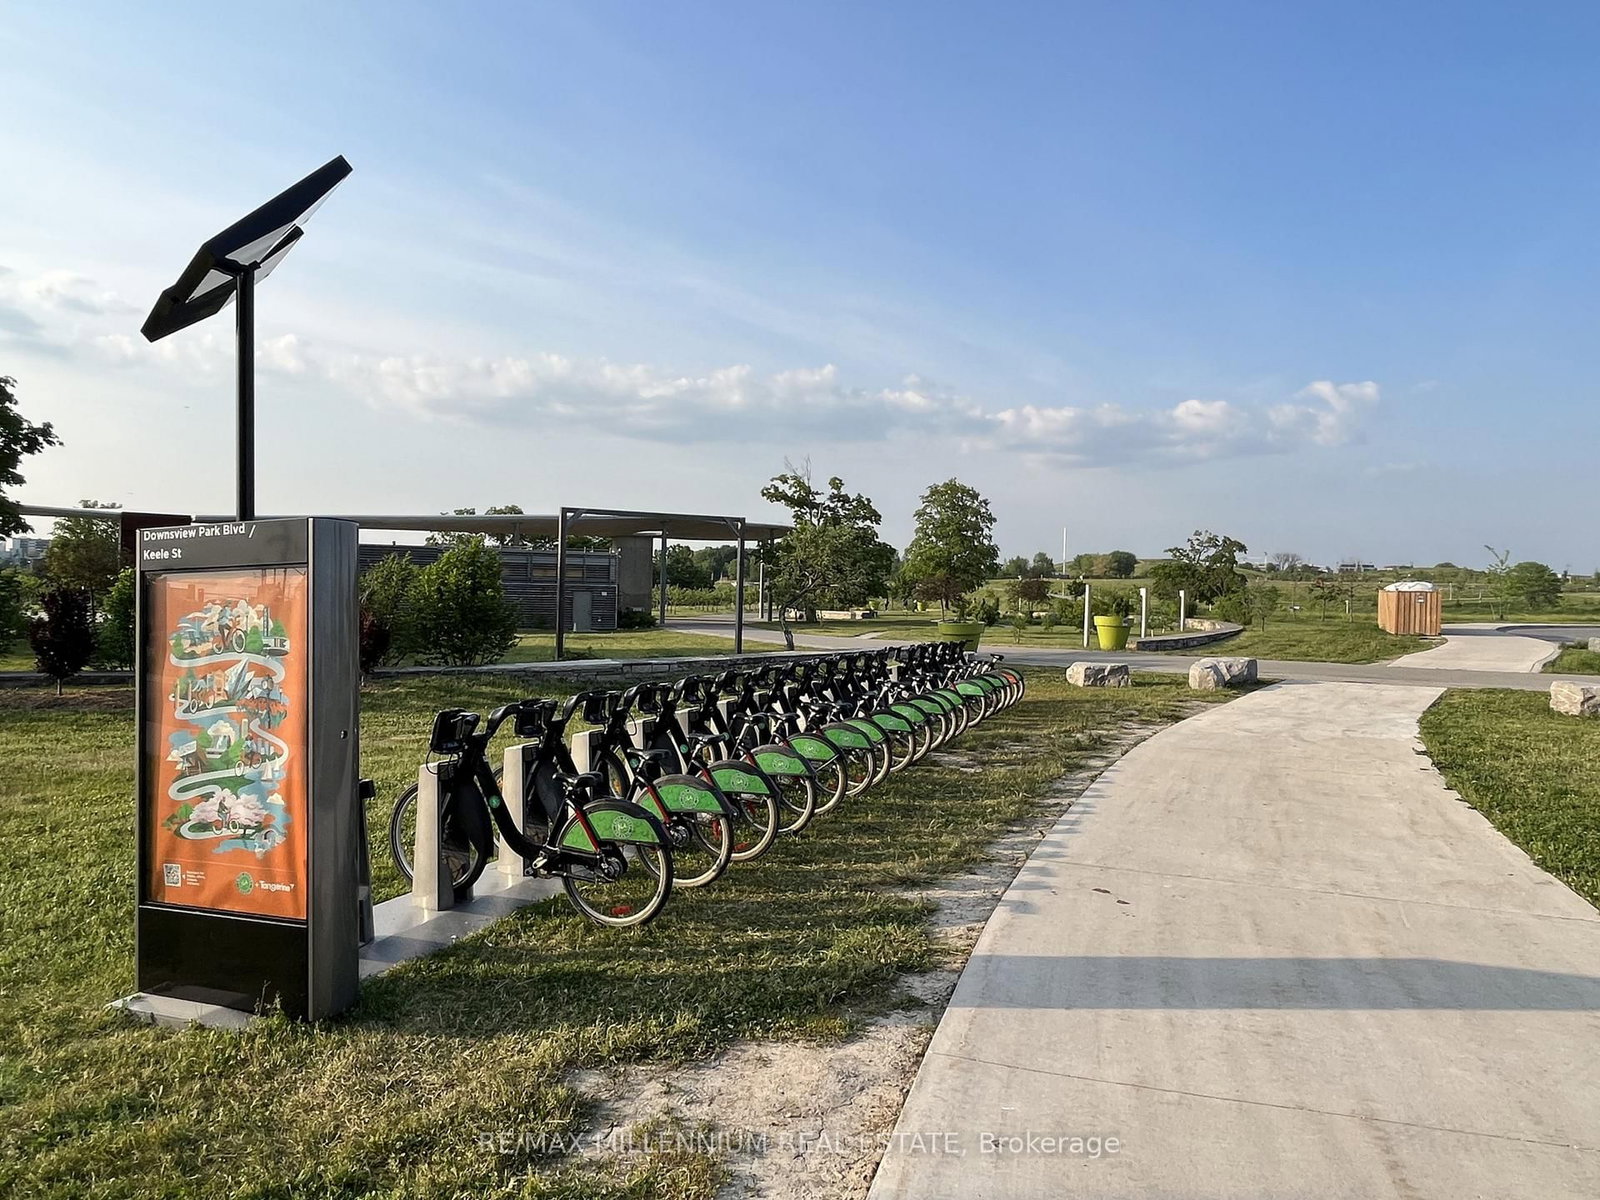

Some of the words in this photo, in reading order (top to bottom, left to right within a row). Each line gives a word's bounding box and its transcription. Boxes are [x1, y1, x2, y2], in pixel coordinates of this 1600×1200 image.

[143, 528, 197, 541] Downsview
[198, 525, 221, 537] Park
[223, 522, 246, 536] Blvd
[248, 524, 256, 539] /
[143, 548, 170, 560] Keele
[171, 548, 182, 559] St
[259, 880, 291, 892] Tangerine
